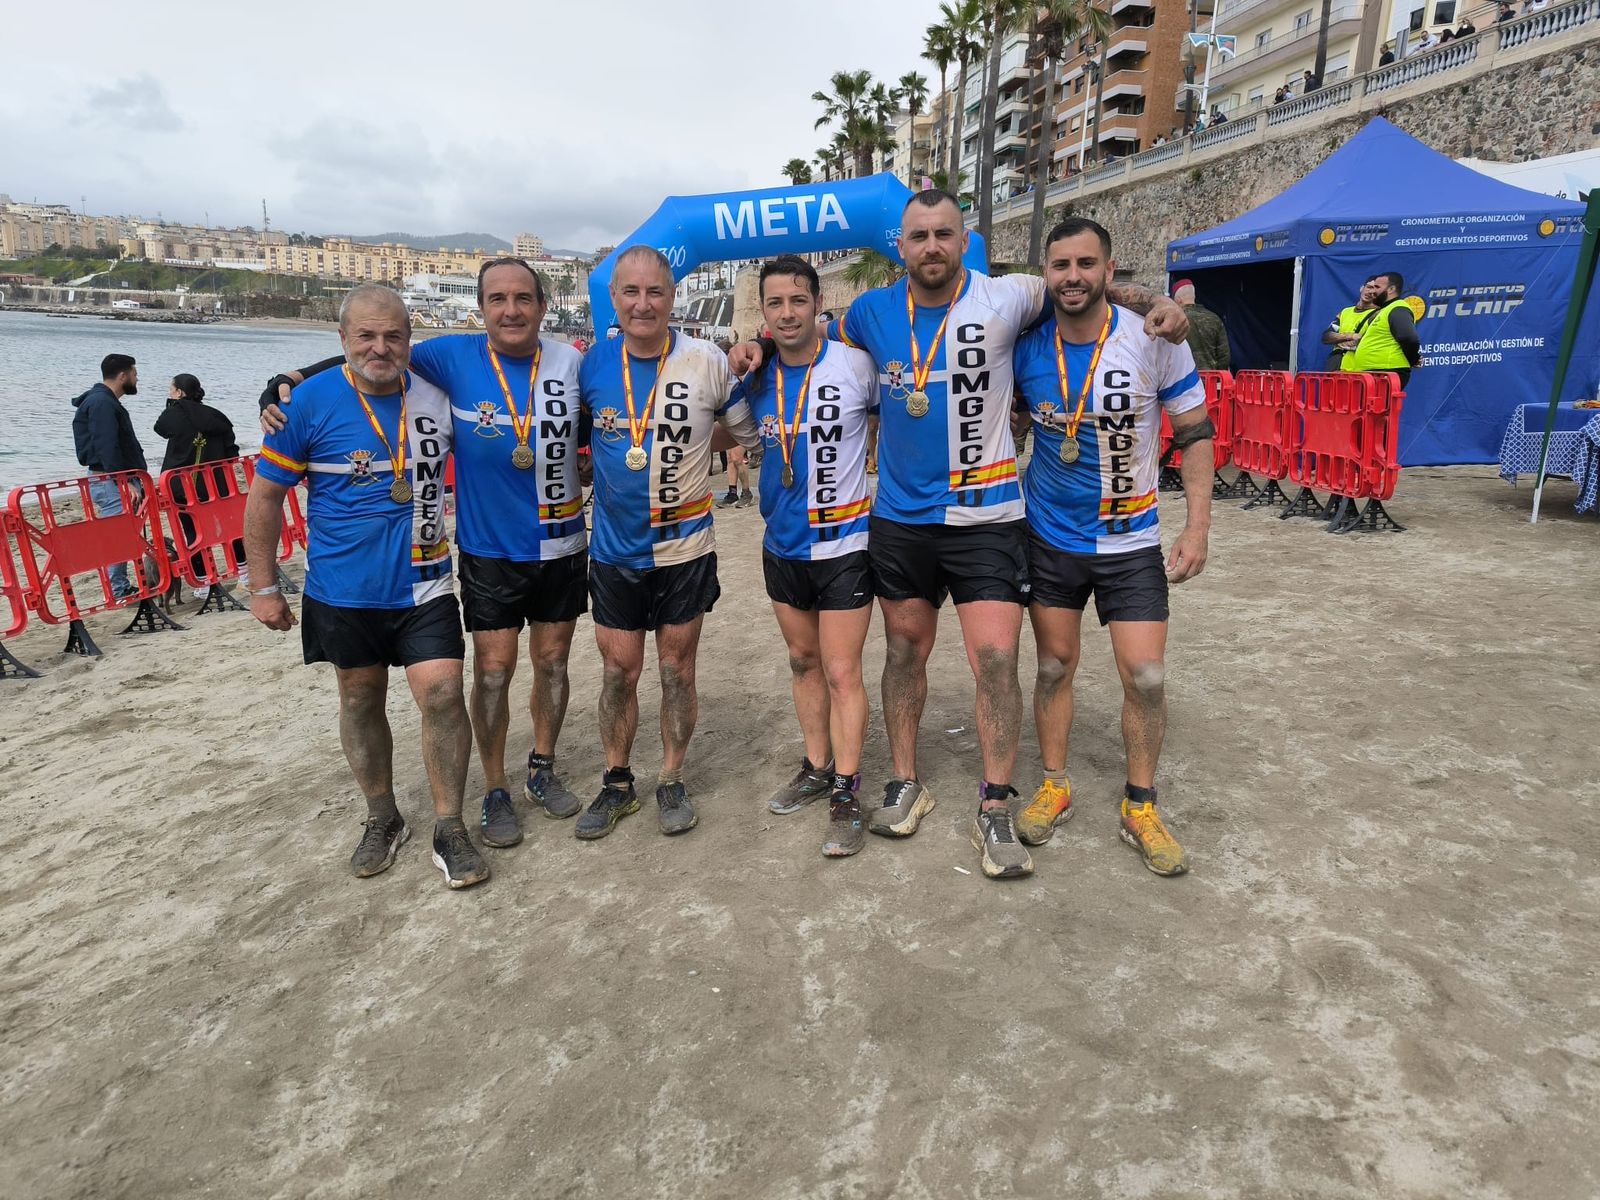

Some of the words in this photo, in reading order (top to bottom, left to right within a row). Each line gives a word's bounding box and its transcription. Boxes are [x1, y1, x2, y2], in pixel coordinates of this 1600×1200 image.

[713, 192, 850, 240] META
[885, 227, 902, 240] DES
[1395, 236, 1430, 246] GESTIÓN
[1430, 237, 1441, 245] DE
[1442, 235, 1478, 244] EVENTOS
[1479, 233, 1529, 243] DEPORTIVOS
[1401, 216, 1465, 226] CRONOMETRAJE
[1465, 212, 1525, 223] ORGANIZACIÓN
[1417, 344, 1433, 354] AJE
[1433, 338, 1494, 353] ORGANIZACIÓN
[1495, 339, 1501, 349] Y
[1501, 336, 1533, 348] GESTIÓN
[1534, 337, 1544, 347] DE
[1451, 352, 1502, 365] DEPORTIVOS
[540, 379, 572, 539] COMGECEU
[657, 381, 692, 542] COMGECEU
[810, 385, 843, 542] COMGECEU
[952, 323, 990, 508] COMGECEU
[1097, 369, 1135, 535] COMGECEU
[415, 416, 443, 581] COMGECEU
